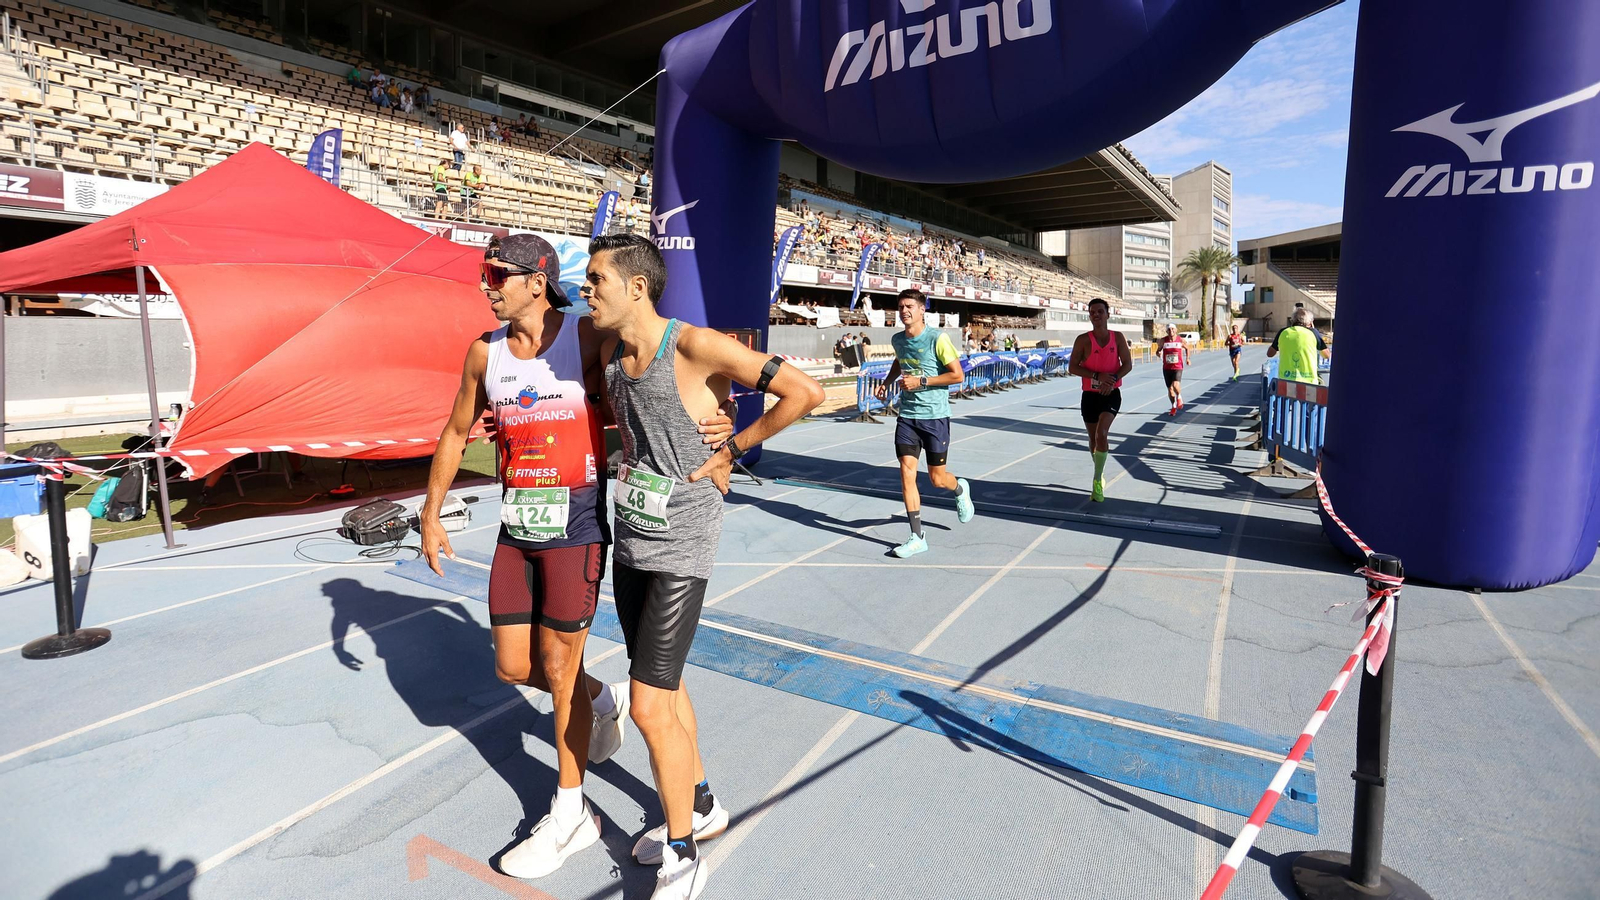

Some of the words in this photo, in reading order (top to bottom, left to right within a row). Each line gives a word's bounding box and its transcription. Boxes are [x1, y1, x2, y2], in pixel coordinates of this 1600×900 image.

[824, 0, 1052, 92] MIZUNO
[1384, 162, 1595, 198] MIZUNO
[505, 410, 576, 426] MOVITRANSA
[515, 467, 558, 478] FITNESS
[627, 488, 646, 510] 48
[516, 506, 552, 525] 124
[24, 551, 42, 569] 8
